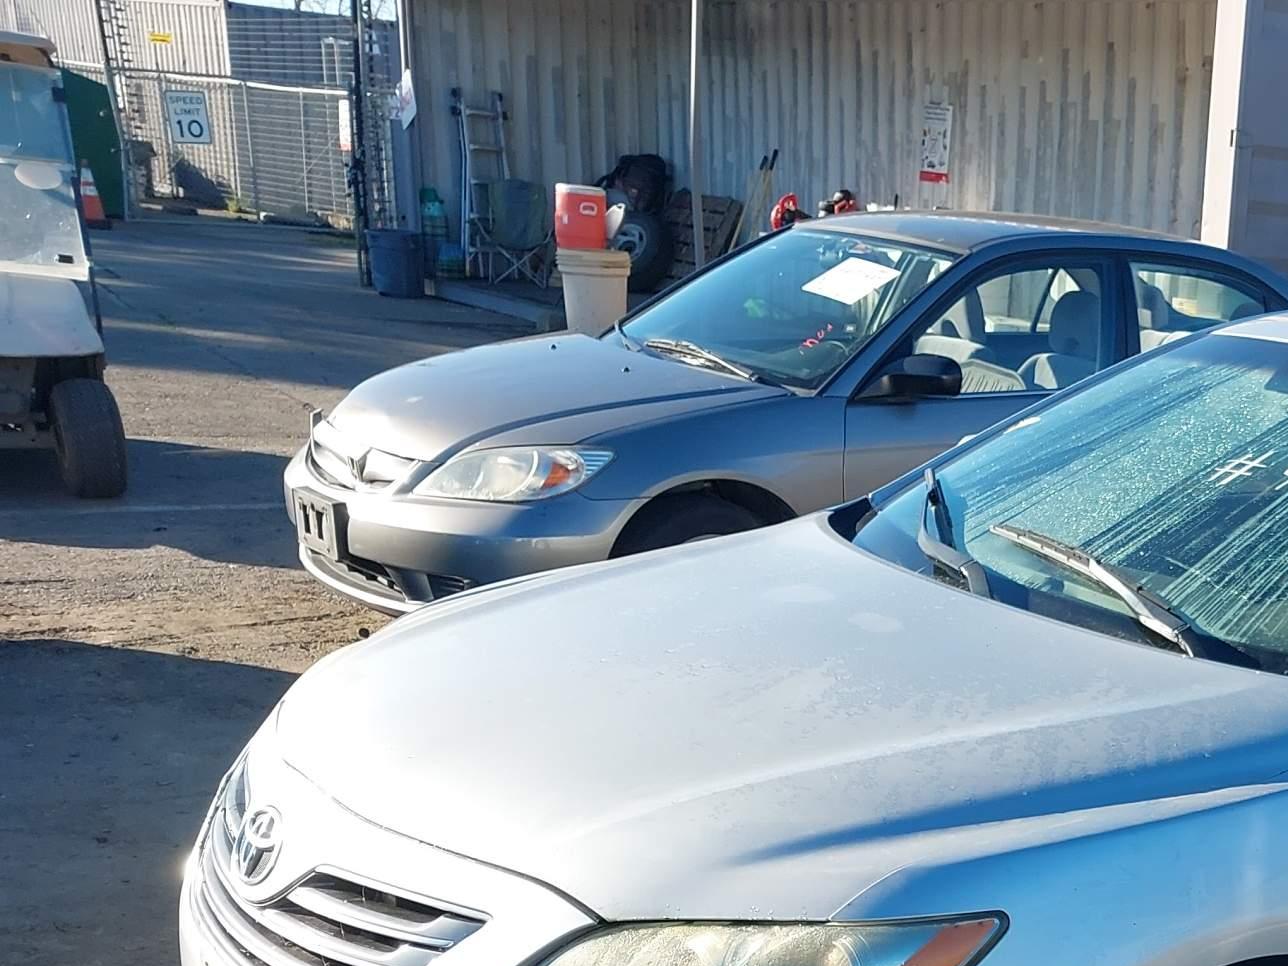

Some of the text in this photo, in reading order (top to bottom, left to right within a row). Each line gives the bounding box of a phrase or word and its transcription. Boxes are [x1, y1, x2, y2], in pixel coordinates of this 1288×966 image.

[168, 95, 203, 105] SPEED
[174, 108, 201, 116] LIMIT
[176, 119, 204, 138] 10
